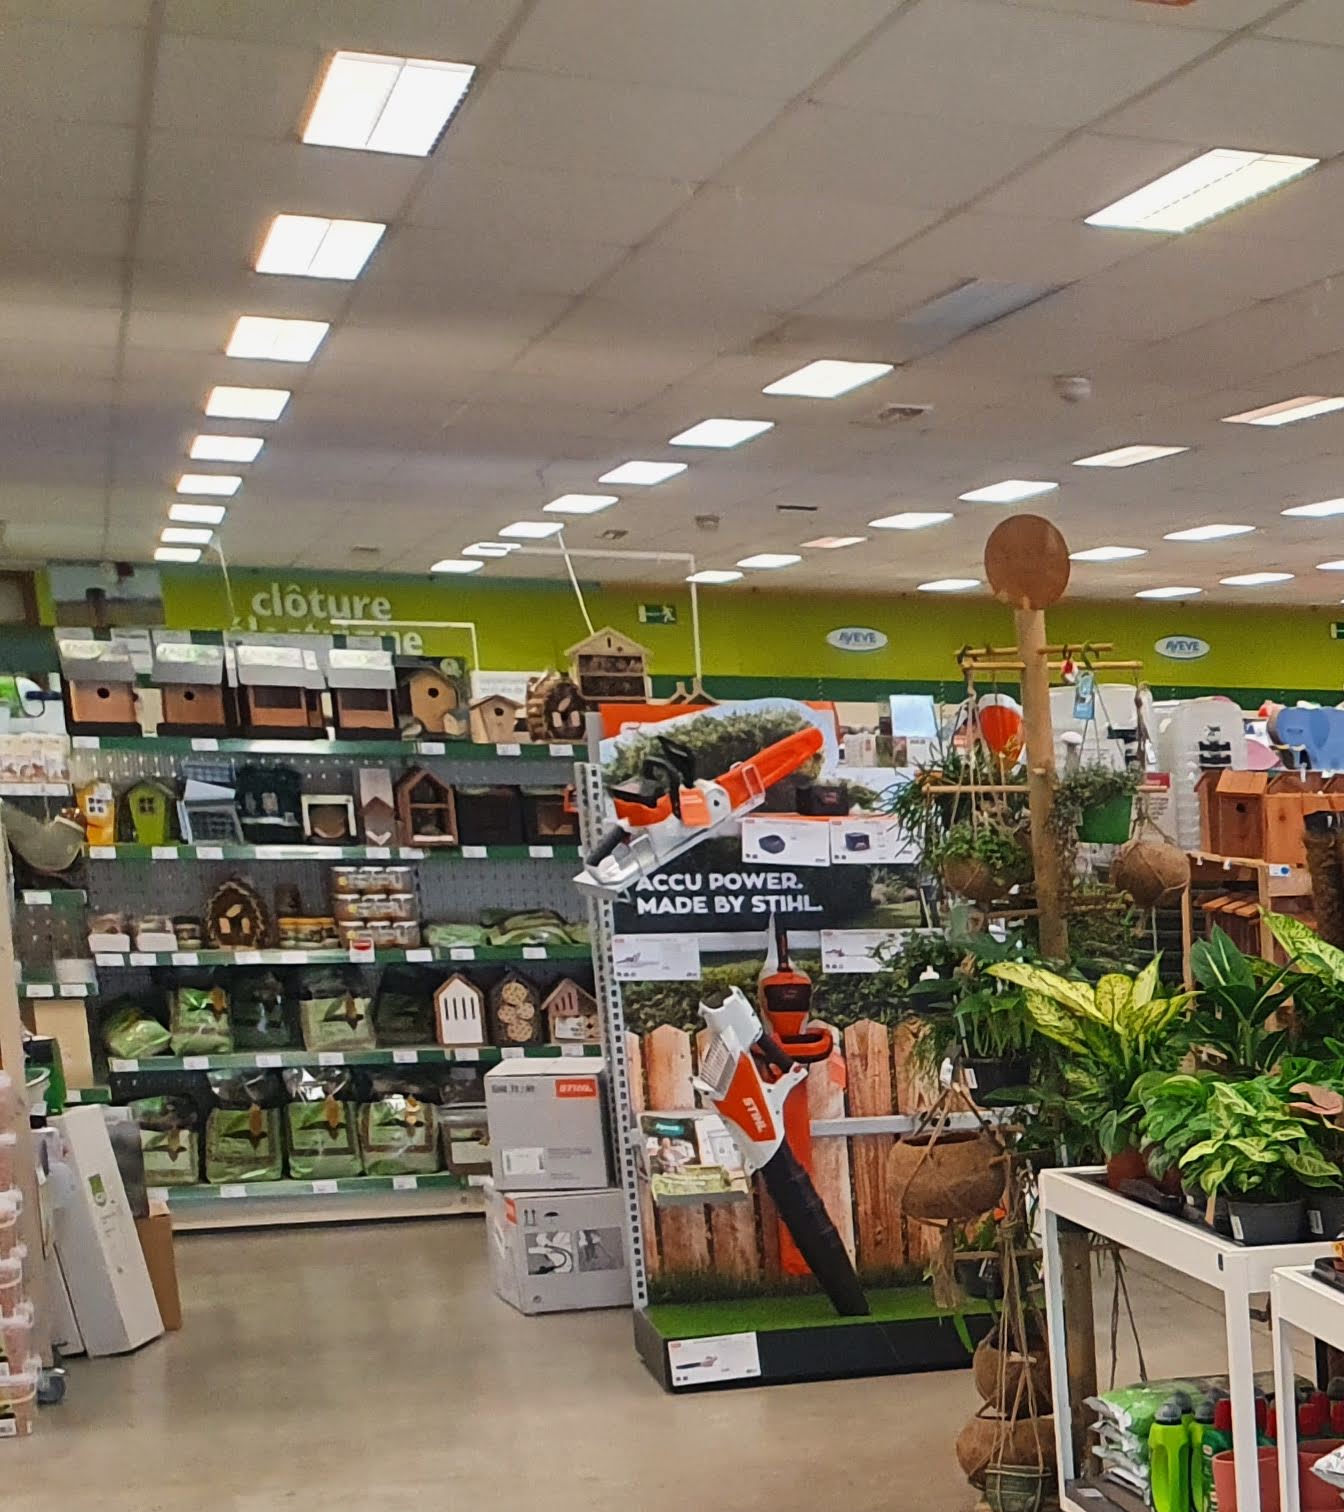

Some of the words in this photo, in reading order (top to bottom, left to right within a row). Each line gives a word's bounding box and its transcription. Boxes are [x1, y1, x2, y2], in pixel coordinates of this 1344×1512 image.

[251, 583, 392, 619] clôture
[636, 873, 702, 891] ACCU
[708, 872, 804, 890] POWER.
[637, 896, 709, 915] MADE
[714, 895, 745, 913] BY
[751, 895, 824, 913] STIHL.
